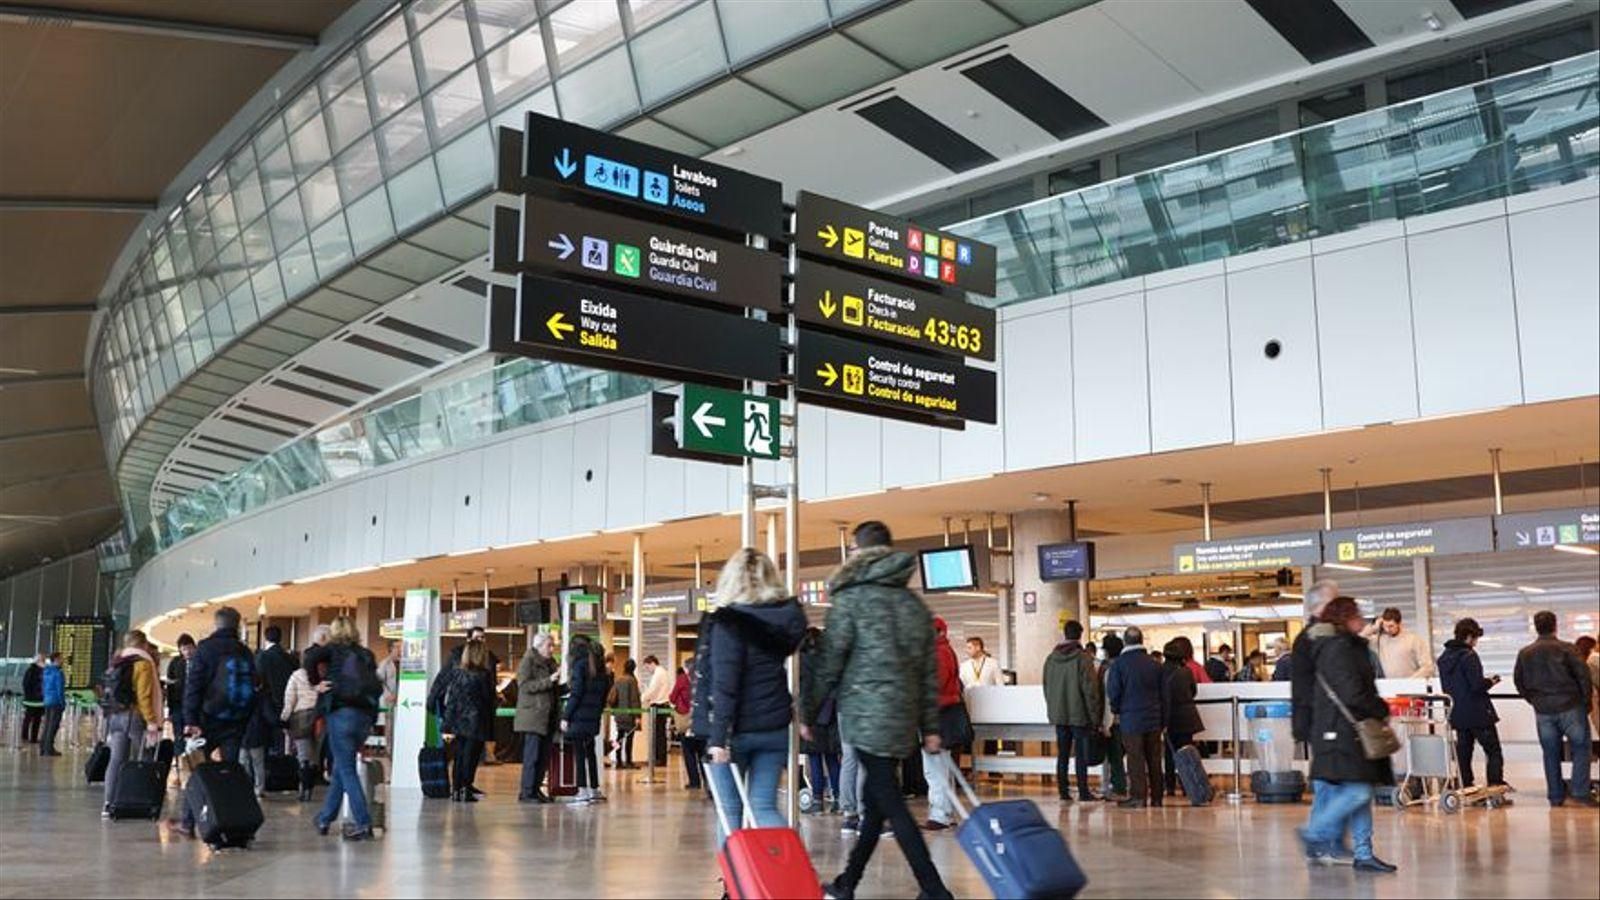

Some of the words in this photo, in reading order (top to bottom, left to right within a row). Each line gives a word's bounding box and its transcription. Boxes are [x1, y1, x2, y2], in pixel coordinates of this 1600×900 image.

[673, 164, 717, 188] Lavabos
[674, 179, 701, 197] Toilets
[672, 193, 706, 213] Aseos
[868, 221, 899, 240] Portes
[649, 236, 693, 258] Guàrdia
[694, 246, 717, 264] Civil
[911, 233, 919, 248] A
[960, 246, 968, 262] R
[649, 252, 680, 269] Guardia
[682, 259, 699, 273] Civil
[868, 248, 903, 268] Puertas
[910, 255, 919, 270] D
[944, 265, 953, 280] F
[694, 276, 717, 292] Civil
[580, 299, 617, 318] Eixida
[868, 288, 916, 311] Facturació
[580, 315, 600, 332] Way
[601, 322, 617, 333] out
[868, 316, 920, 338] Facturación
[580, 330, 617, 349] Salida
[924, 318, 950, 345] 43
[957, 325, 981, 352] 63
[868, 356, 900, 373] Control
[902, 364, 913, 376] de
[915, 368, 955, 385] seguretat
[868, 370, 897, 387] Security
[868, 383, 900, 400] Control
[902, 391, 913, 402] de
[915, 395, 957, 411] seguridad
[1357, 532, 1384, 542] Control
[1386, 531, 1395, 540] de
[1396, 528, 1433, 539] seguretat
[1357, 548, 1385, 558] Control
[1386, 548, 1395, 556] de
[1397, 544, 1434, 556] seguridad
